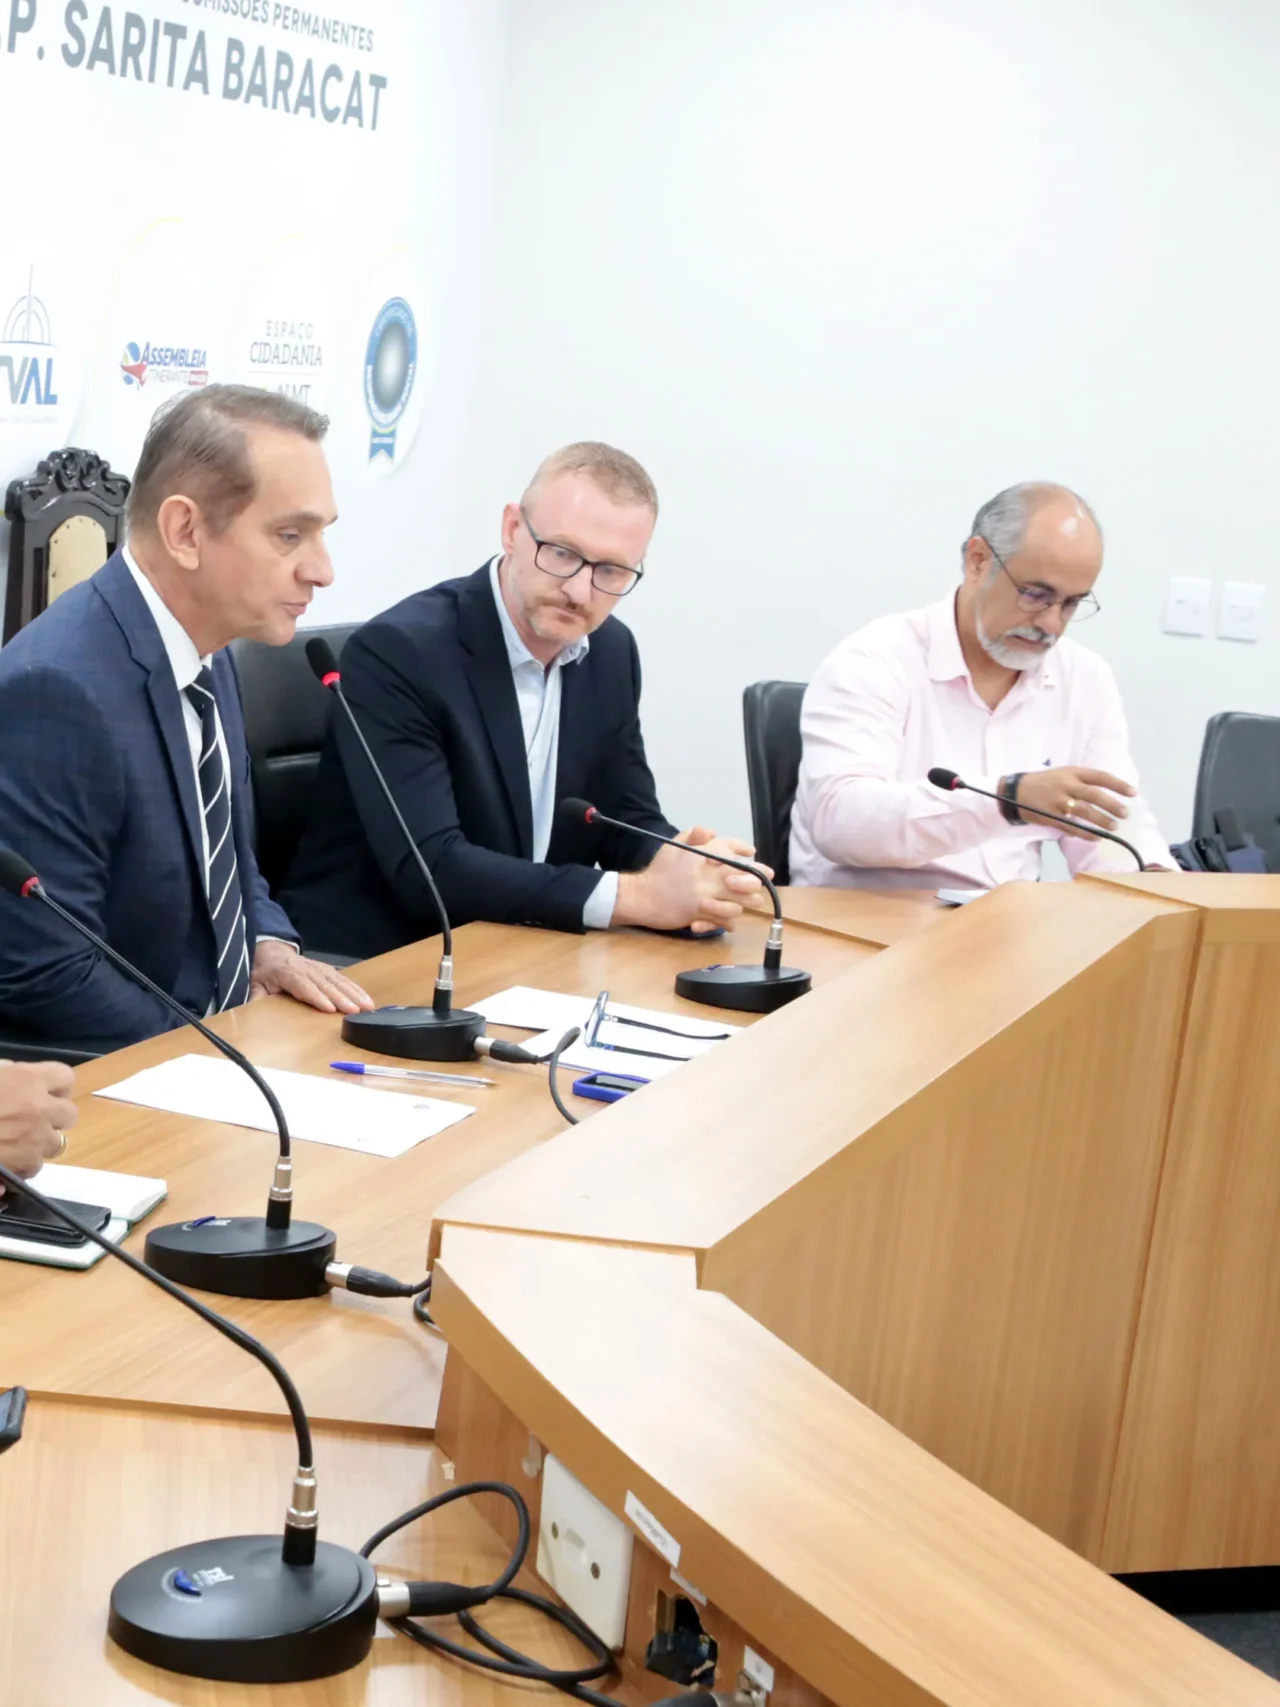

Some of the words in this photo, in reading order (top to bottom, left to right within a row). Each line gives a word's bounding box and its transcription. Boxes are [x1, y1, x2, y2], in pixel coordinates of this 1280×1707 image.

[272, 3, 375, 52] PERMANENTES
[60, 0, 210, 95] SARITA
[222, 37, 388, 131] BARACAT
[266, 319, 314, 342] ESPAÇO
[249, 341, 323, 367] CIDADANIA
